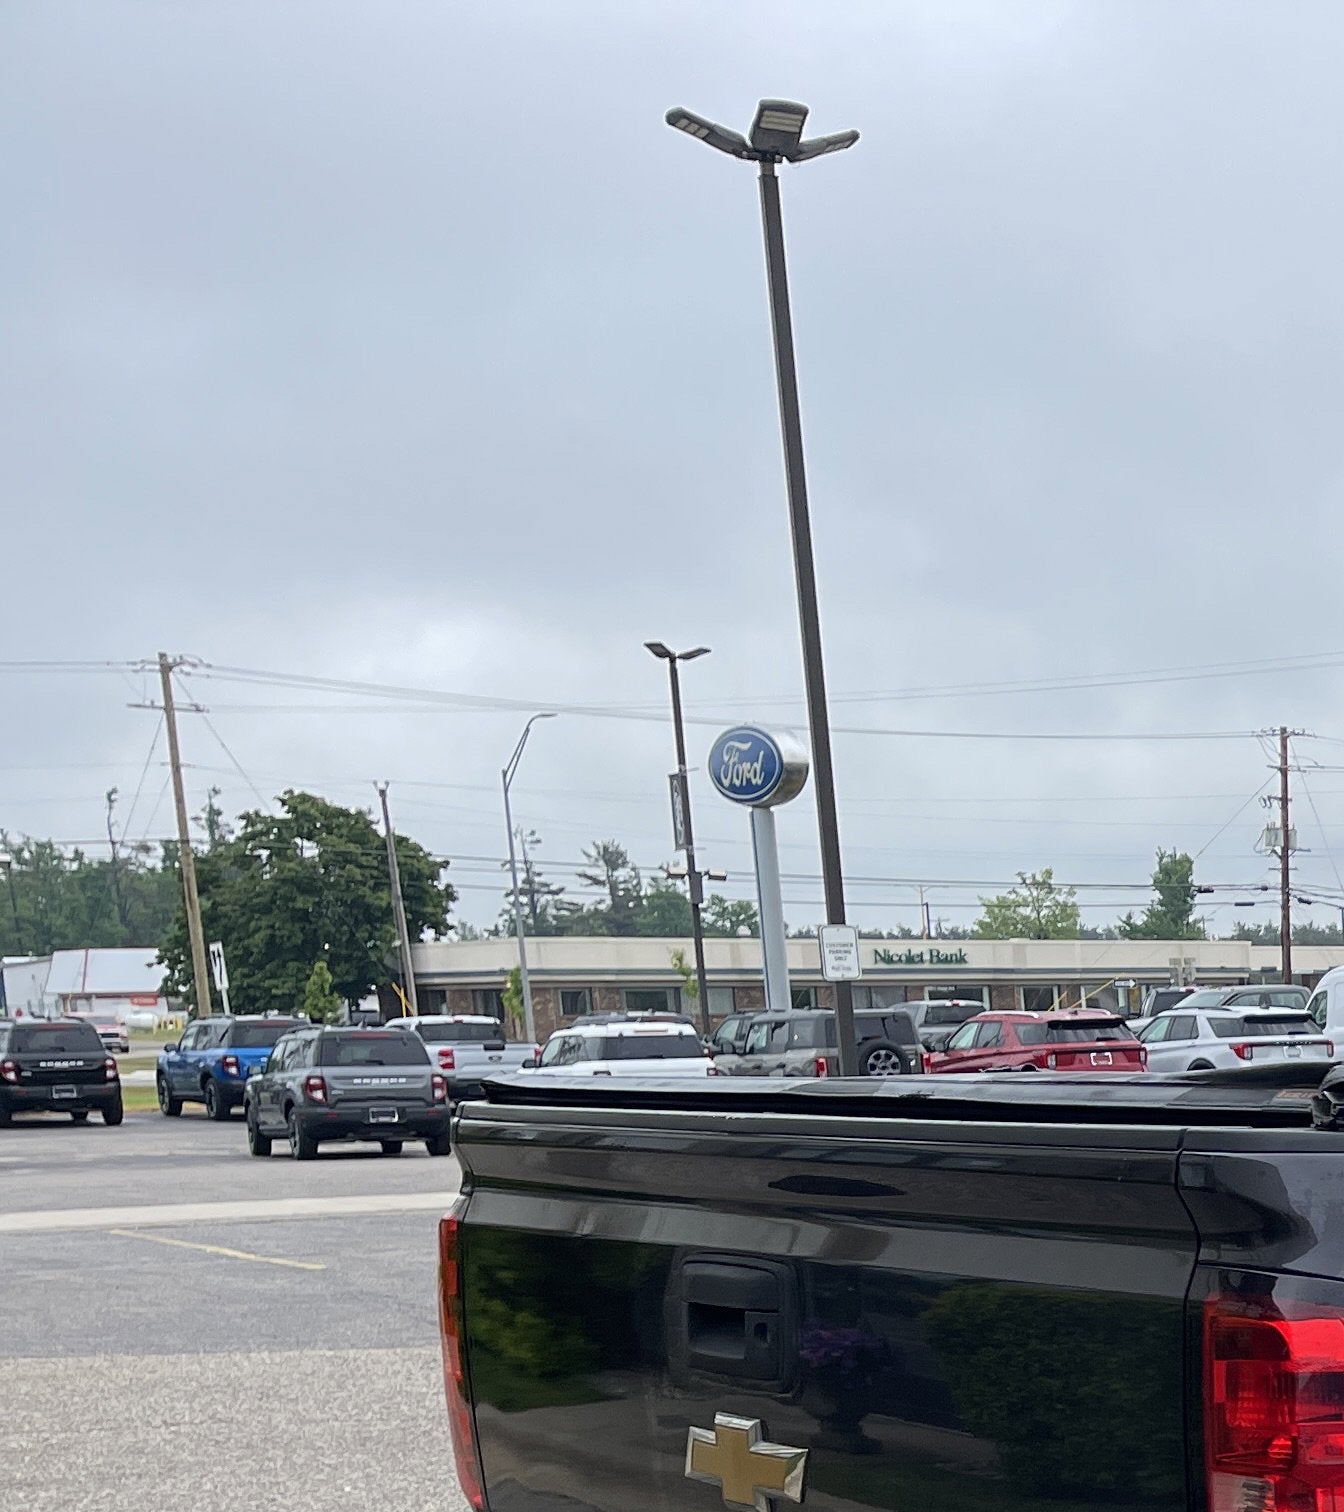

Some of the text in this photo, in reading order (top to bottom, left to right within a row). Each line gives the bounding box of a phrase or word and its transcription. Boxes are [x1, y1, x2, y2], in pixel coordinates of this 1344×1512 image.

[720, 740, 765, 788] Ford
[873, 947, 968, 965] Nicolet Bank
